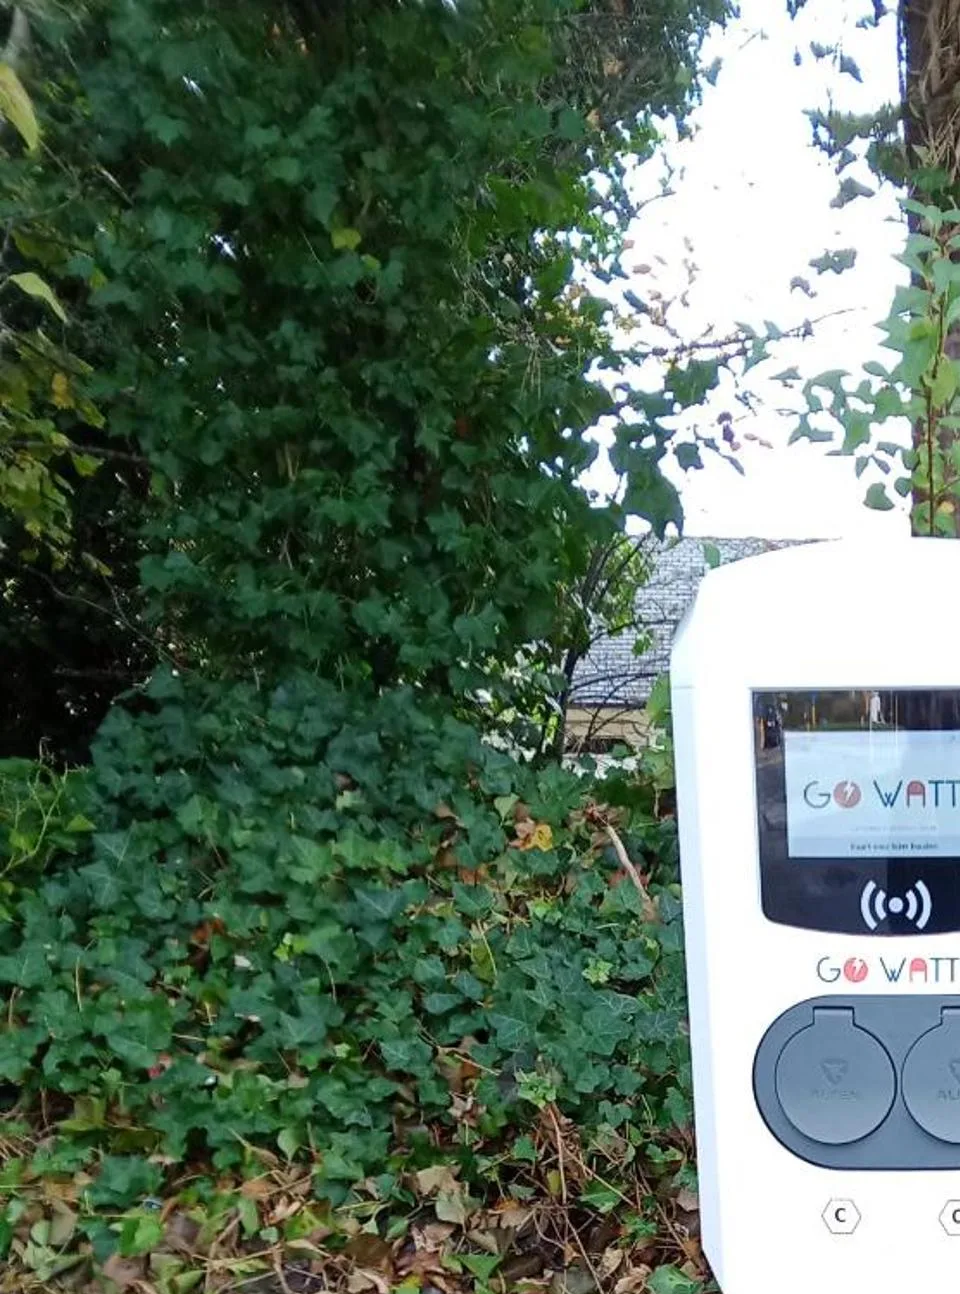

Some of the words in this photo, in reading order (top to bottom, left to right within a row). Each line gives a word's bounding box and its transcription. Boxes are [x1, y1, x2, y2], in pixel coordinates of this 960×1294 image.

[803, 779, 862, 809] GO
[816, 956, 869, 983] GO
[834, 1207, 846, 1223] C
